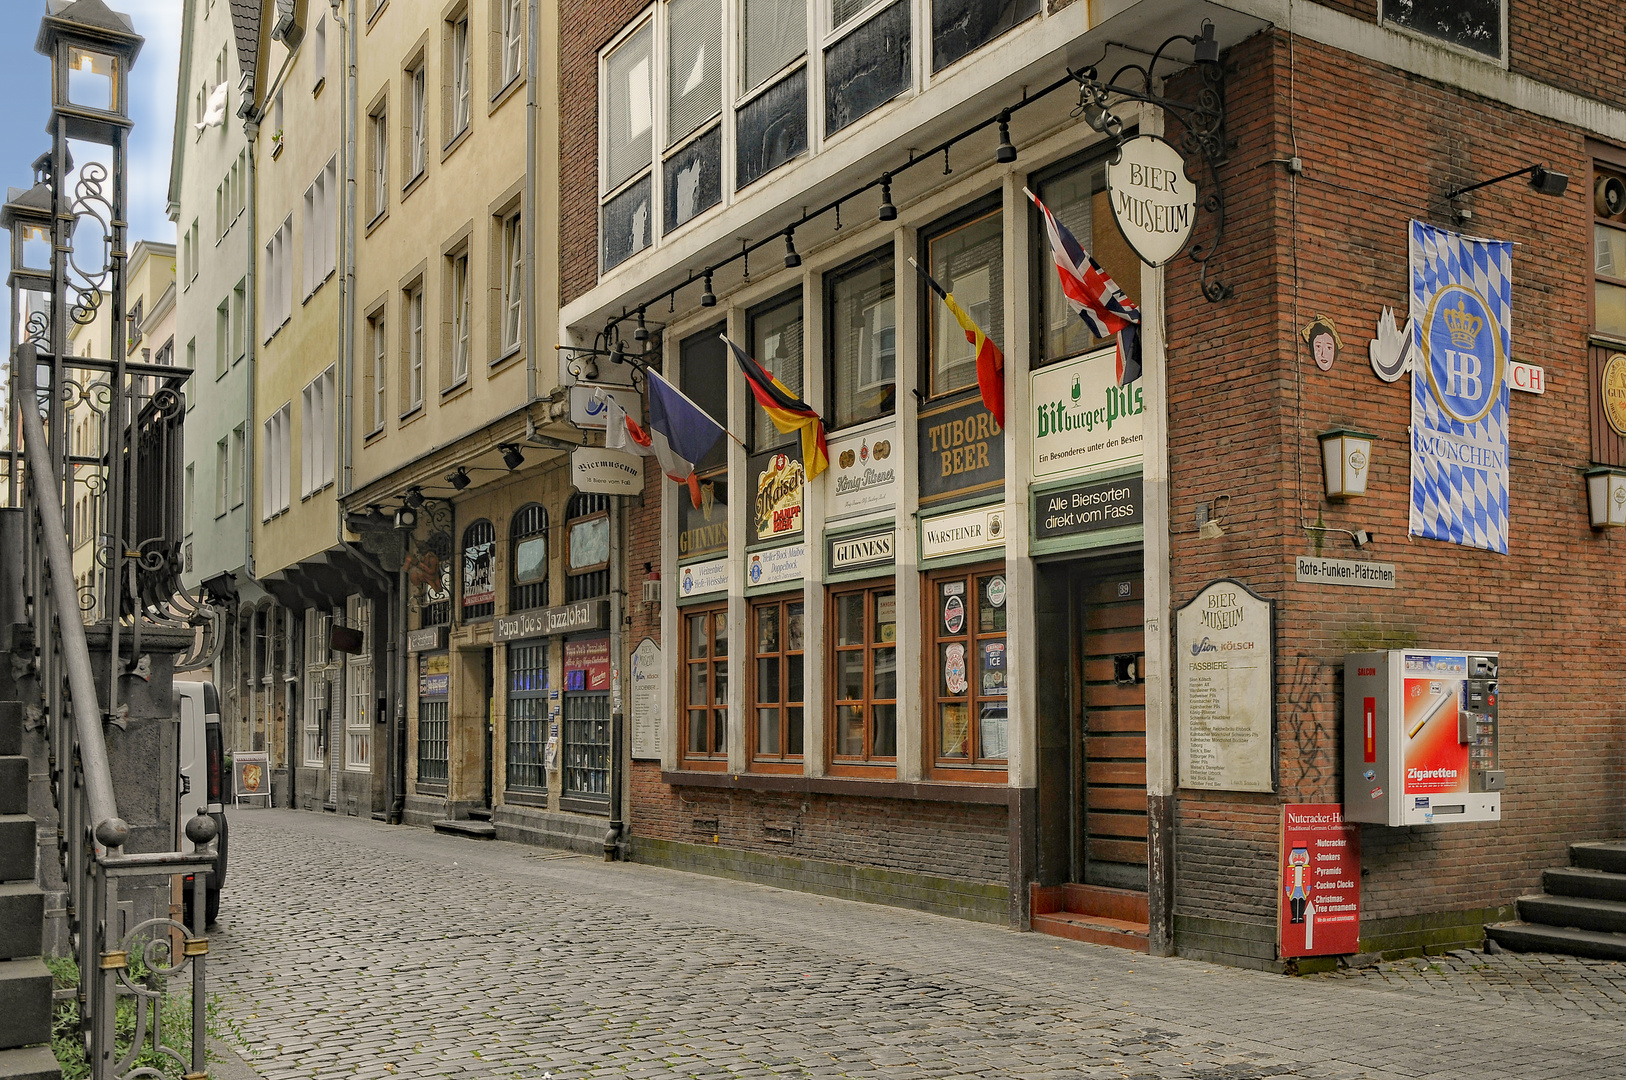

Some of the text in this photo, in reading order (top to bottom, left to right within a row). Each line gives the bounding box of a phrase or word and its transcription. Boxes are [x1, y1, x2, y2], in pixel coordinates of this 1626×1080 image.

[1130, 162, 1178, 195] BIER
[1117, 196, 1189, 234] MUSEUM
[1445, 349, 1482, 401] HB
[1514, 366, 1541, 390] CH
[1037, 383, 1143, 438] Bitburger Pils
[929, 412, 1002, 452] TUBORG
[941, 441, 990, 477] BEER
[1039, 434, 1143, 463] Ein Besonderes unter den Besten
[1417, 435, 1504, 470] MÜNCHEN
[578, 460, 638, 477] Biermuseum
[1048, 486, 1130, 512] Alle Biersorten
[773, 505, 801, 522] DAMPF
[1045, 503, 1134, 529] direkt vom Fass
[773, 519, 792, 532] BIER
[927, 524, 982, 544] WARSTEINER
[837, 539, 890, 562] GUINNESS
[1300, 560, 1393, 581] Rote-Funken-Plätzchen
[1120, 584, 1128, 594] 39
[1208, 593, 1237, 608] BIER
[499, 604, 590, 639] Papa Joe's Jazzlokal
[1201, 606, 1244, 630] MUSEUM
[1221, 642, 1254, 651] KÖLSCH
[990, 657, 1000, 666] ICE
[1189, 662, 1228, 670] FASSBIERE
[1408, 768, 1457, 781] Zigaretten
[1337, 880, 1354, 889] Clocks
[1329, 903, 1356, 912] ornaments
